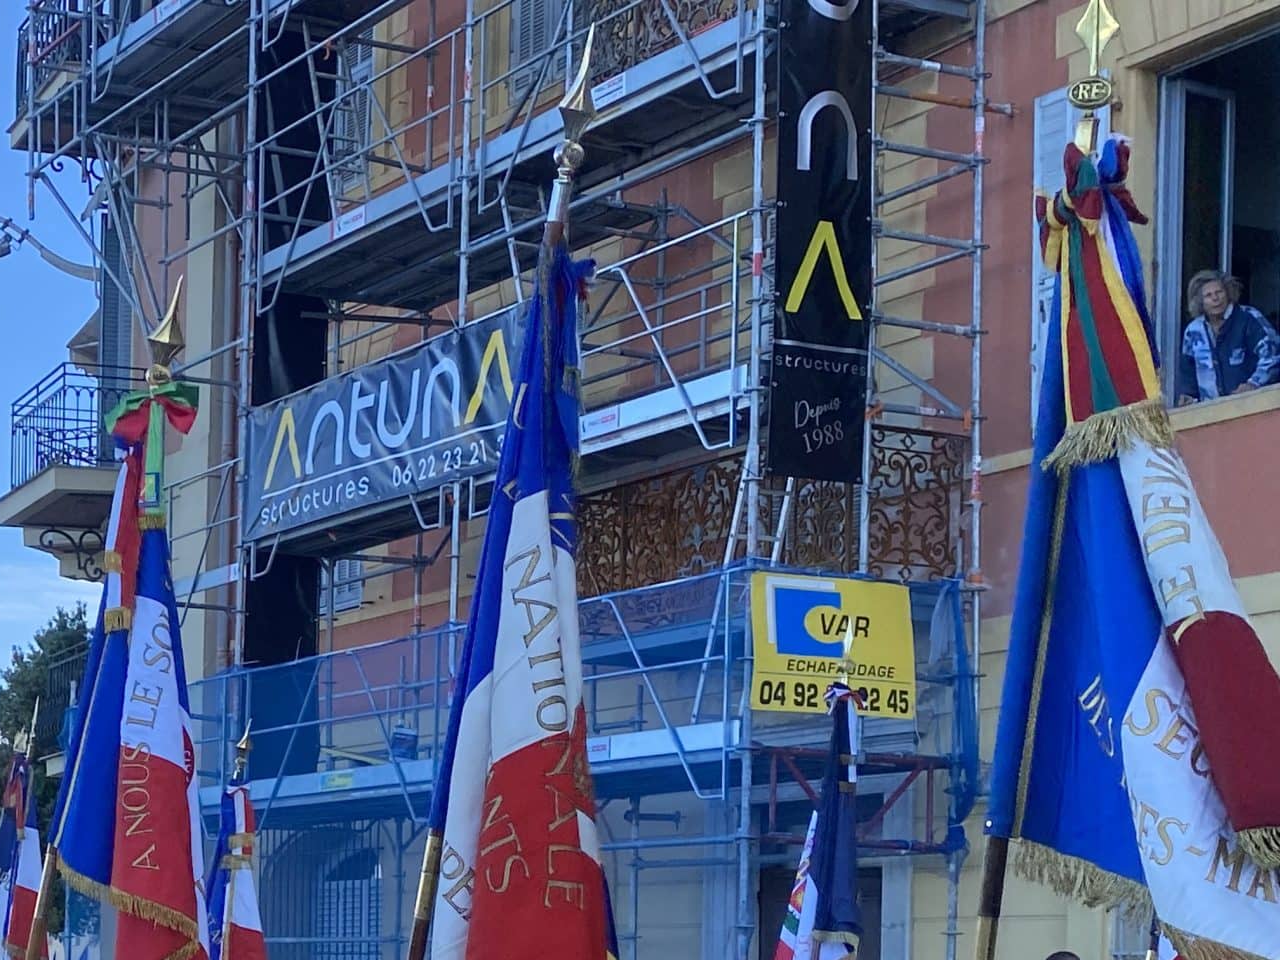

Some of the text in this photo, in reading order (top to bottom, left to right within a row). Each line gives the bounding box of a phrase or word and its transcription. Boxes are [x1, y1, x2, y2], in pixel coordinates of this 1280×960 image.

[775, 354, 866, 377] structures
[803, 420, 844, 454] 1988
[260, 476, 370, 525] structures
[392, 464, 413, 488] 06
[418, 456, 437, 481] 22
[442, 447, 463, 473] 23
[469, 439, 487, 465] 21
[820, 612, 870, 638] VAR
[126, 679, 164, 730] LE
[759, 680, 786, 706] 04
[793, 682, 818, 708] 92
[887, 689, 909, 714] 45
[120, 741, 153, 838] NOUS
[131, 843, 160, 871] A
